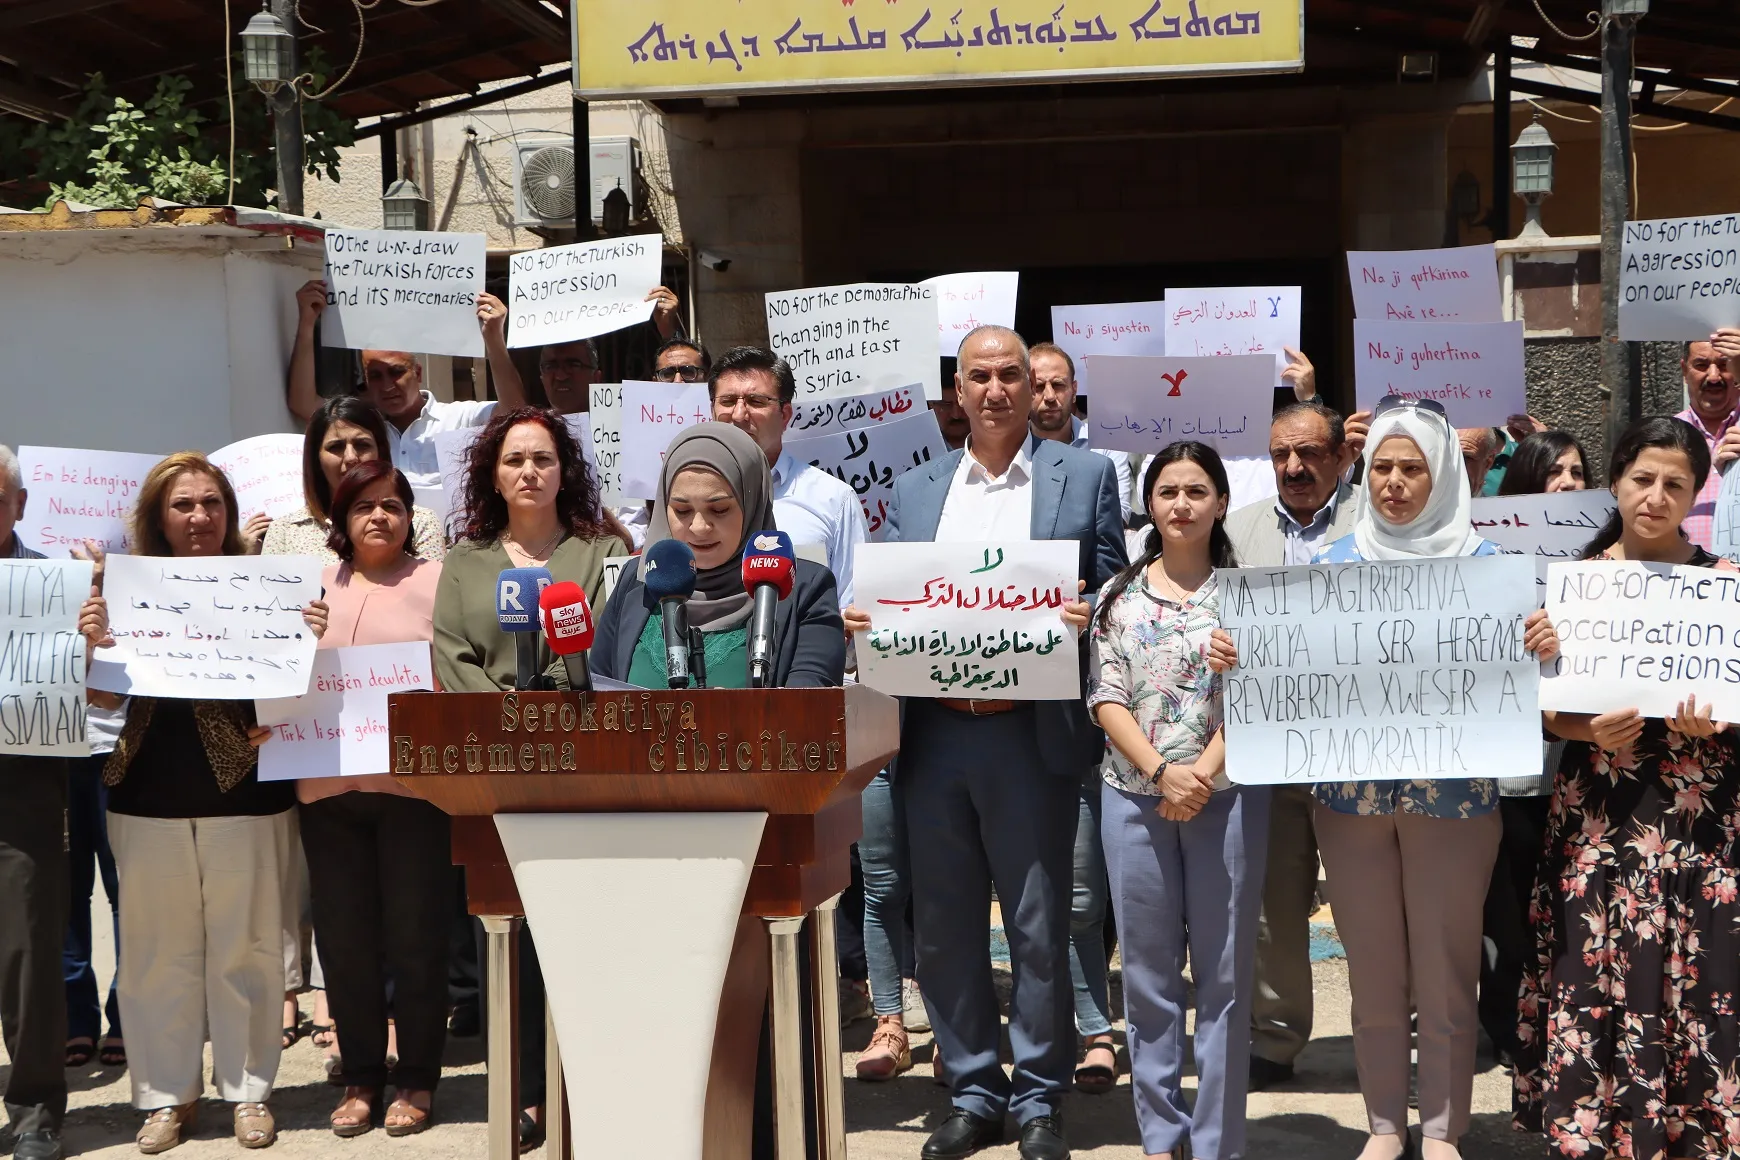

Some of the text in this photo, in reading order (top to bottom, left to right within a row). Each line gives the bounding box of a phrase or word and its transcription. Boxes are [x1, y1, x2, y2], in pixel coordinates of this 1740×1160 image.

[1693, 219, 1723, 238] the
[325, 261, 350, 276] the
[1626, 248, 1737, 275] Aggression
[515, 272, 617, 302] Aggression
[1362, 266, 1386, 284] Na
[1391, 270, 1401, 288] ji
[325, 286, 358, 306] and
[394, 288, 475, 306] mercenaries
[1625, 284, 1649, 302] on
[1653, 283, 1686, 302] our
[1267, 296, 1281, 318] لا
[516, 313, 536, 329] on
[543, 310, 574, 325] our
[847, 318, 859, 335] in
[862, 316, 891, 335] the
[1064, 321, 1081, 336] Na
[1085, 324, 1094, 339] ji
[825, 343, 855, 361] and
[1368, 341, 1481, 371] Na ji guhertina
[1160, 368, 1188, 397] لا
[1478, 388, 1492, 399] re
[33, 464, 54, 481] Em
[750, 558, 779, 568] NEWS
[969, 547, 1004, 574] لا
[500, 580, 525, 611] R
[1223, 575, 1257, 619] NA
[1264, 571, 1291, 616] JI
[556, 615, 582, 628] news
[560, 606, 576, 619] sky
[1333, 622, 1364, 666] LI
[1377, 618, 1415, 665] SER
[368, 663, 421, 688] dewleta
[1554, 652, 1740, 684] our regions
[1227, 668, 1522, 726] RÊVEBERIYA XWESER A
[501, 690, 697, 743] Serokatiya
[273, 722, 305, 742] Tirk
[394, 732, 578, 774] Encûmena
